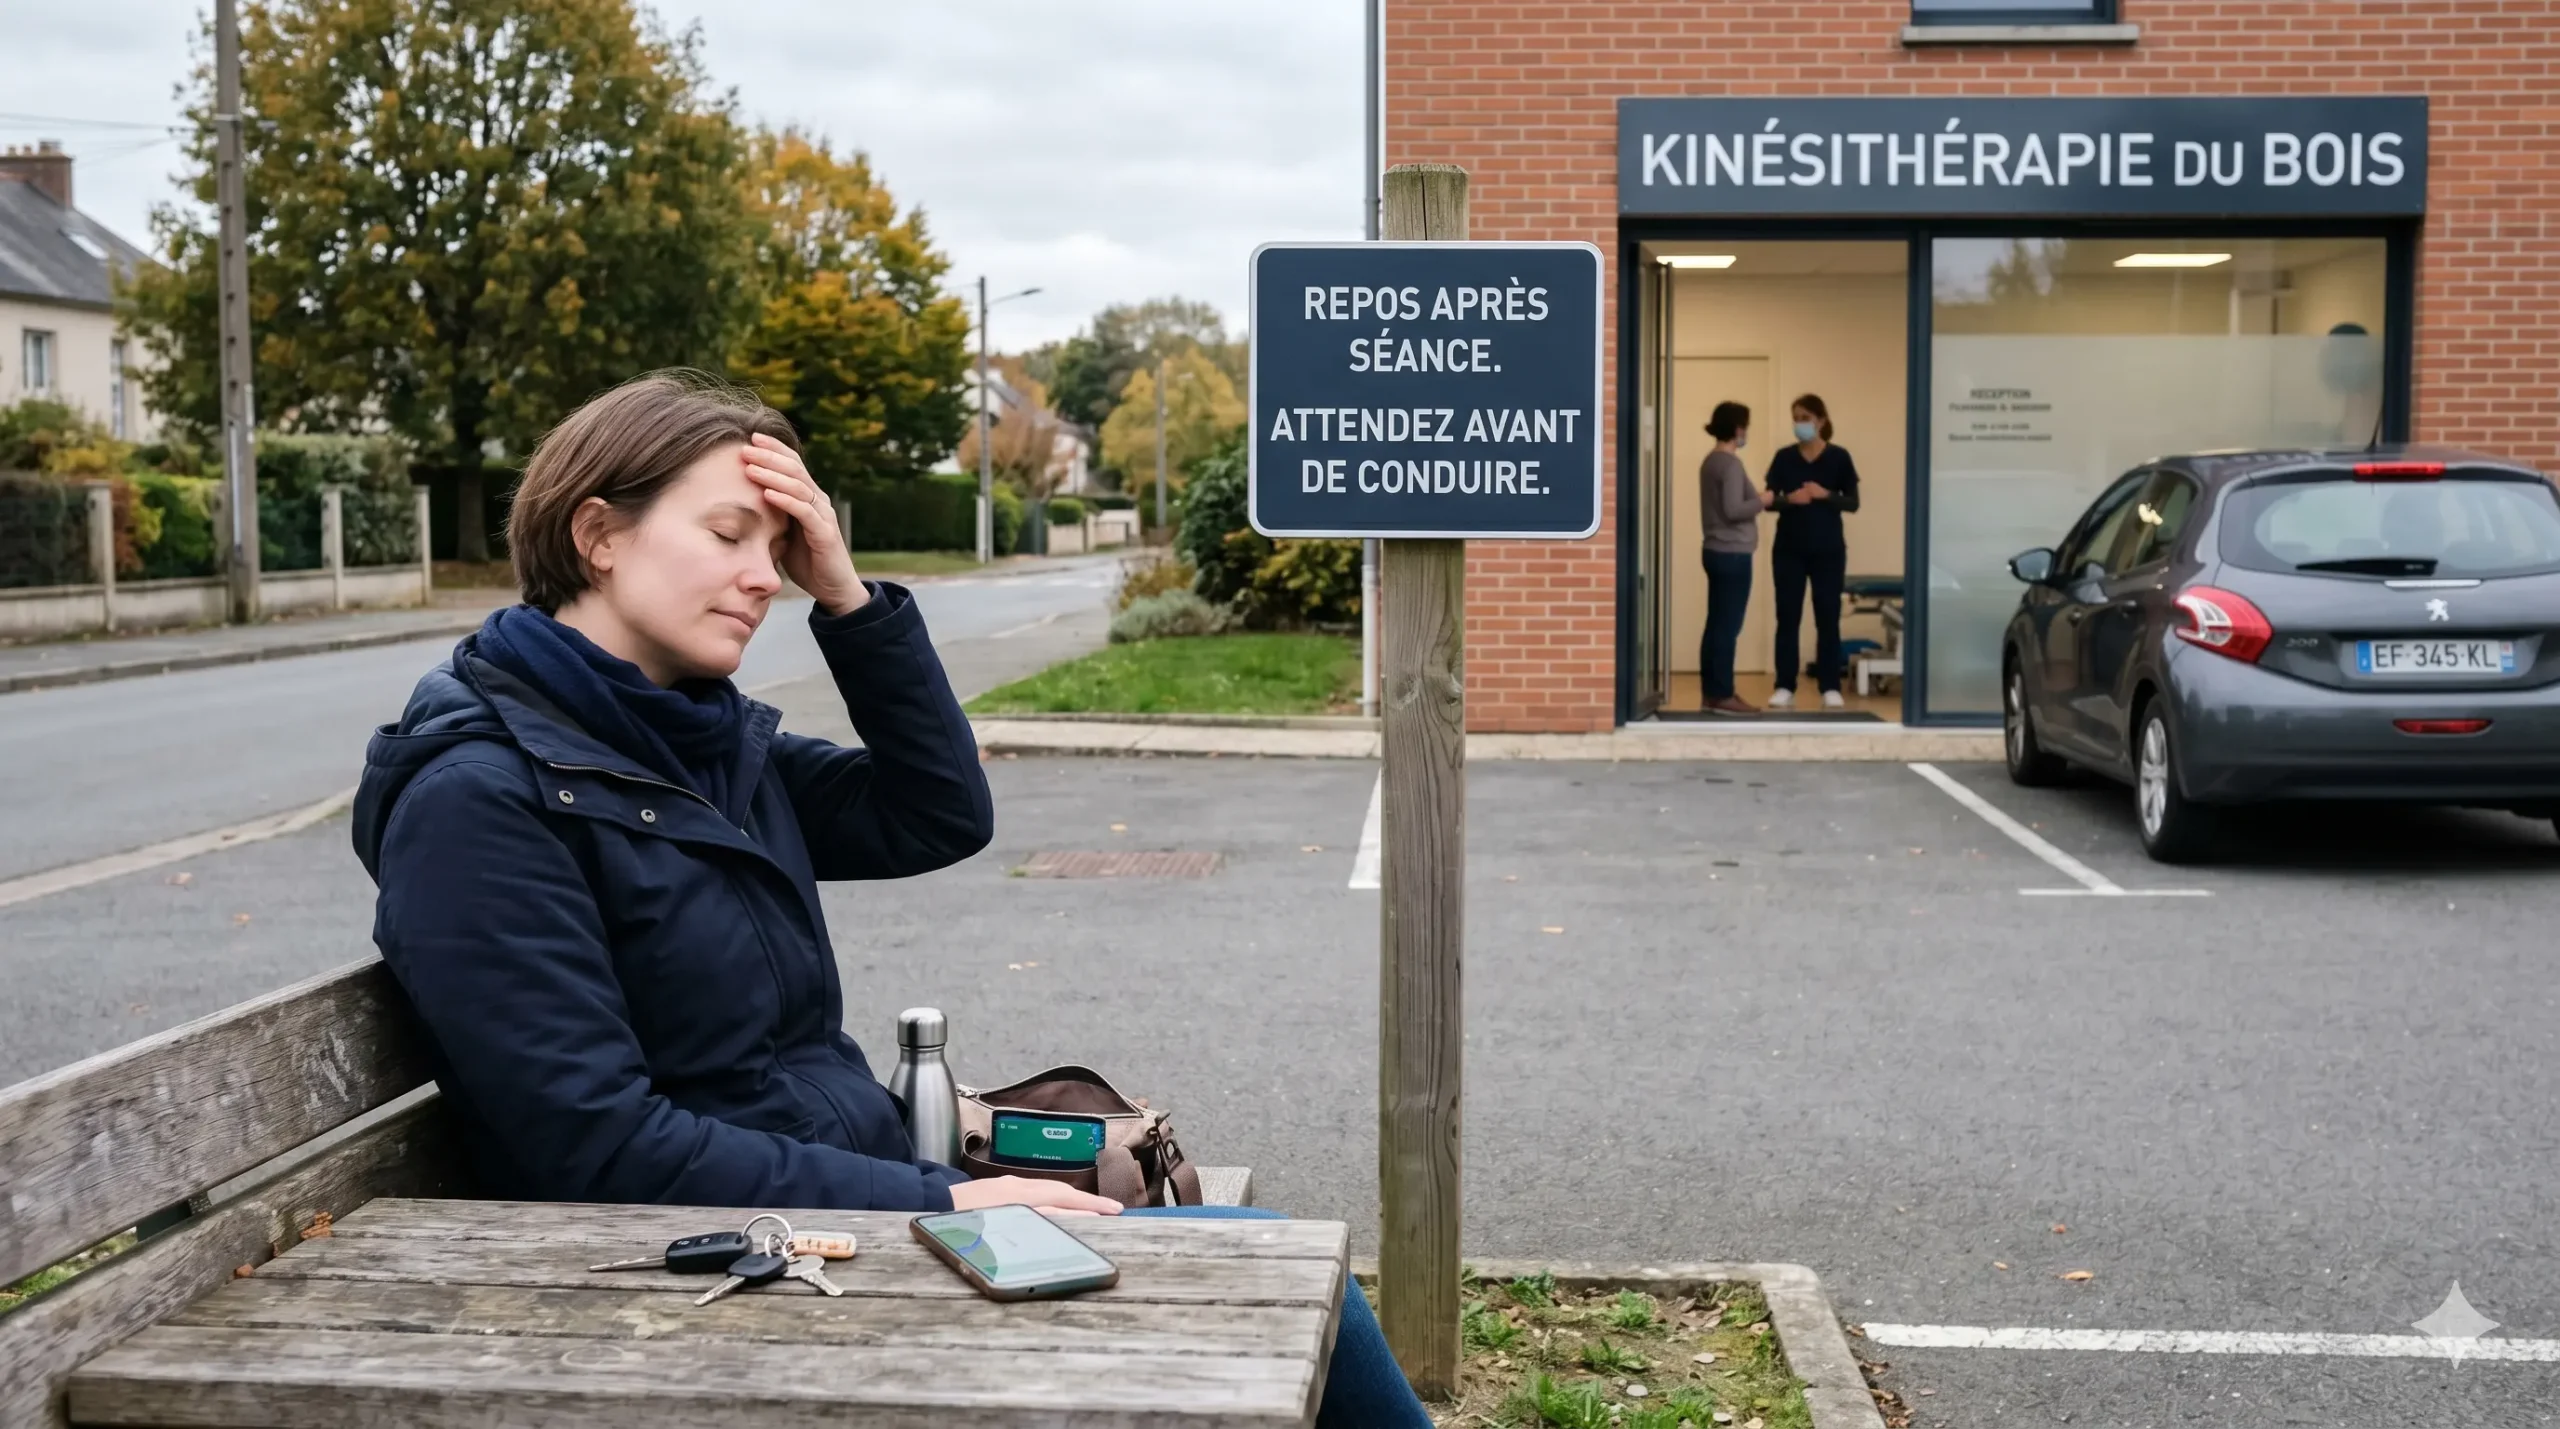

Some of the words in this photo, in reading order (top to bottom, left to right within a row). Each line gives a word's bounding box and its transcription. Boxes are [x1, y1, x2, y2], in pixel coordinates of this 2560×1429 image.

[1642, 117, 2154, 186] KINÉSITHÉRAPIE
[2174, 141, 2244, 186] DU
[2263, 132, 2405, 186] BOIS
[1304, 286, 1421, 320] REPOS
[1430, 277, 1549, 321] APRÈS
[1349, 328, 1502, 373] SÉANCE.
[1270, 408, 1455, 442] ATTENDEZ
[1463, 409, 1581, 443] AVANT
[1302, 459, 1347, 493] DE
[1358, 460, 1550, 494] CONDUIRE.
